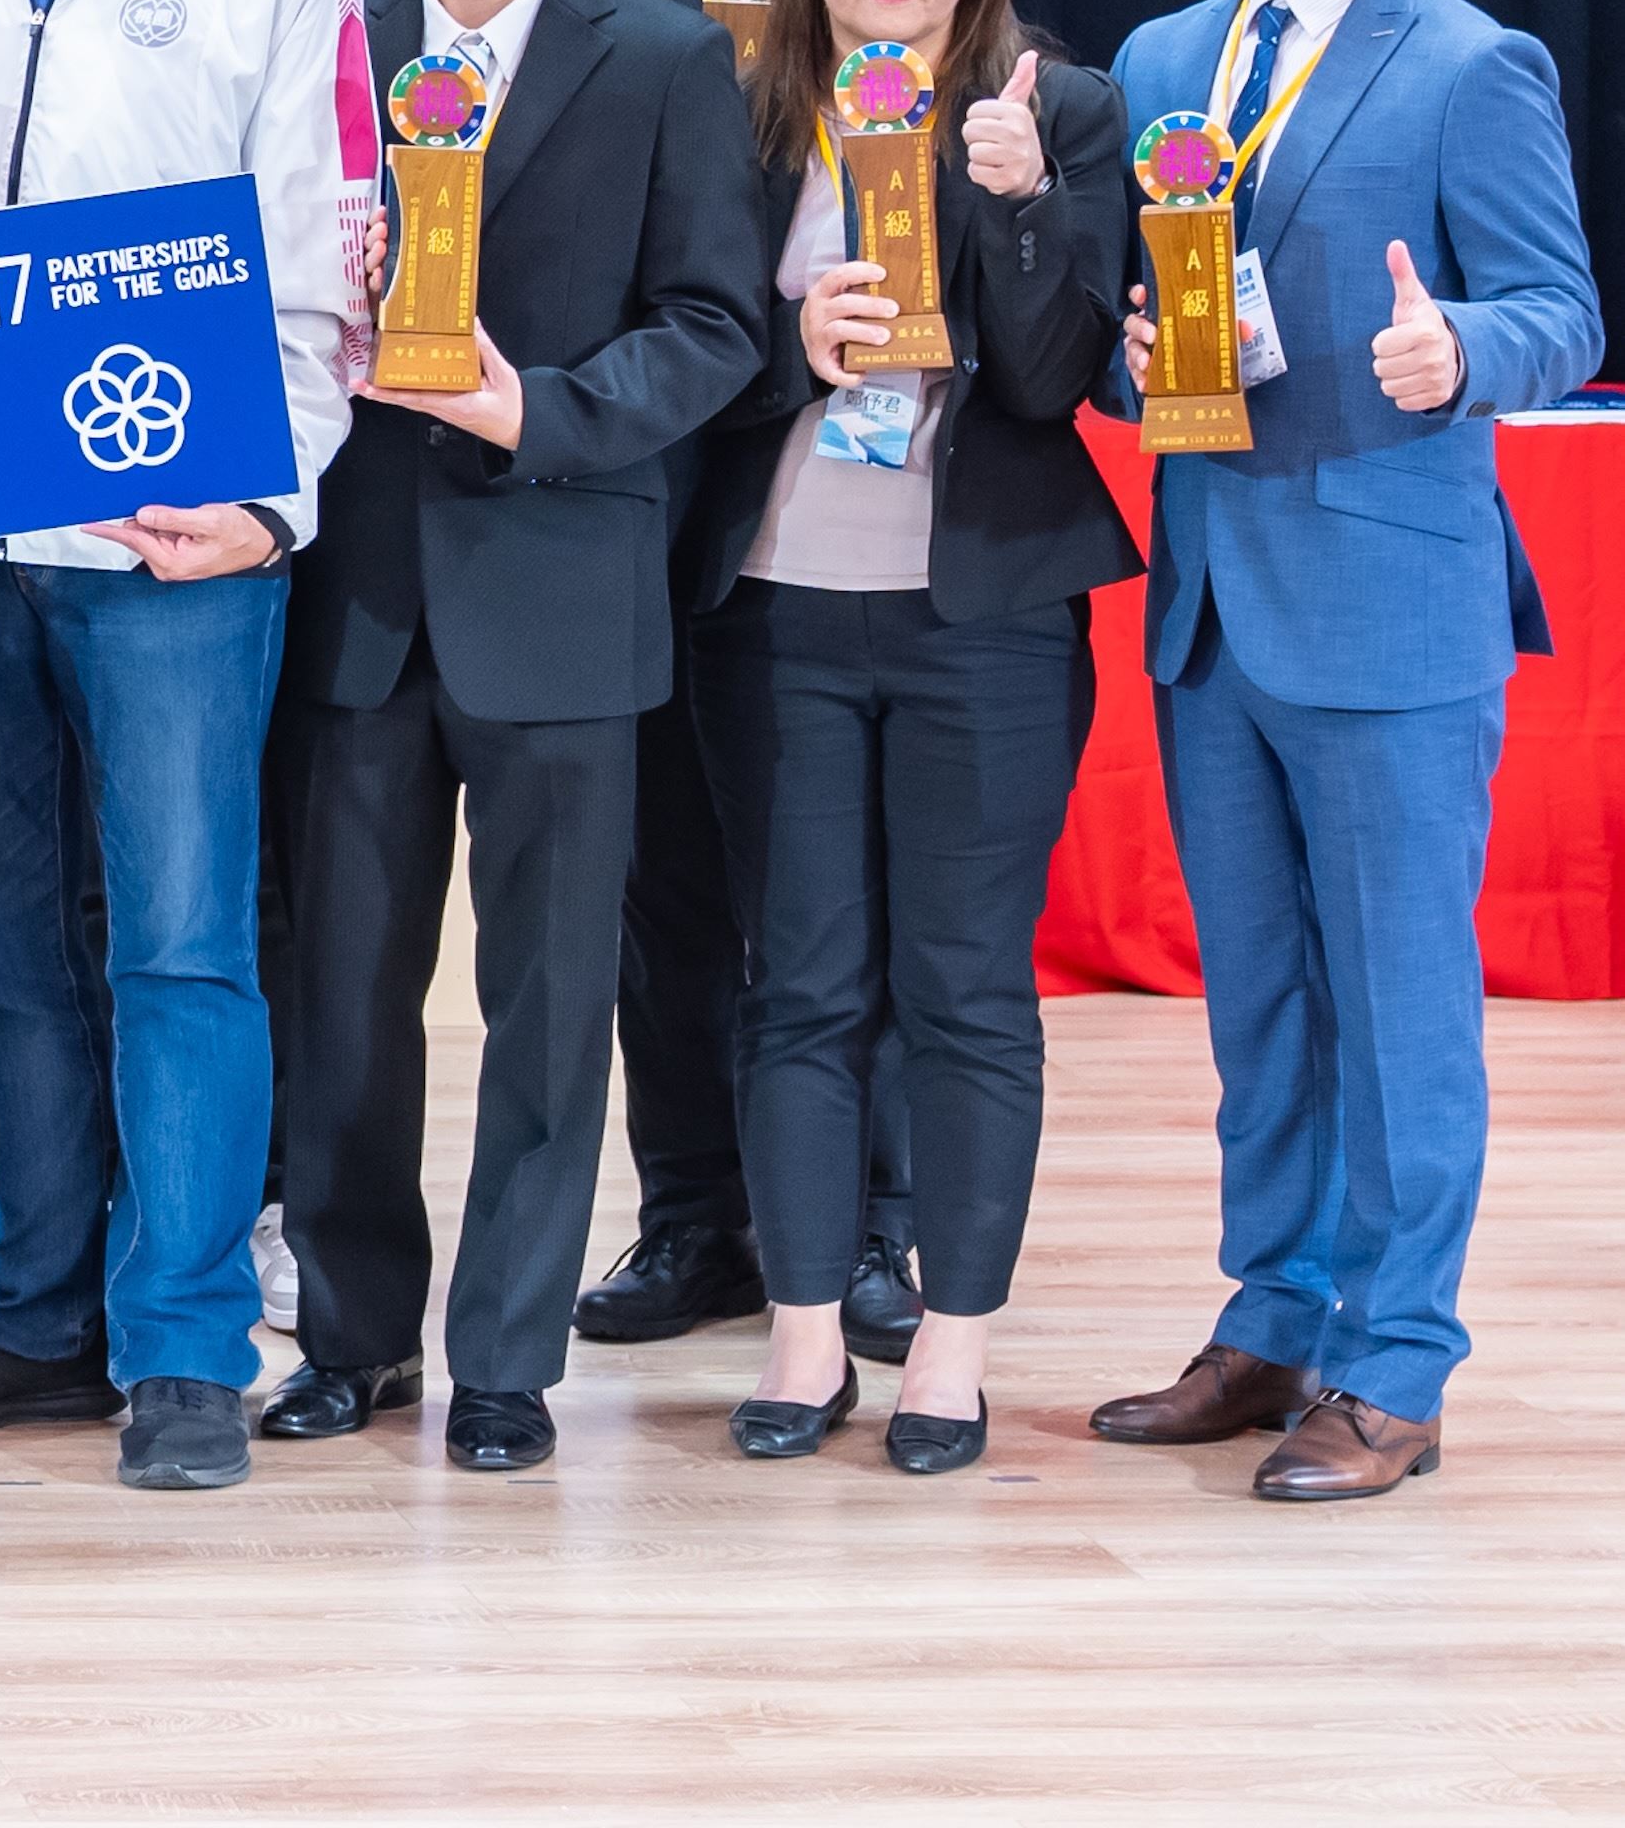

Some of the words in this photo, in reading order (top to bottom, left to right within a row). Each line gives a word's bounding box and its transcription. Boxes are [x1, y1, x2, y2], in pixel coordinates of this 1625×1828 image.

[884, 209, 913, 239] 級
[427, 227, 455, 256] 級
[46, 233, 230, 283] PARTNERSHIPS
[50, 281, 101, 310] FOR
[113, 271, 163, 300] THE
[174, 258, 250, 291] GOALS
[1181, 288, 1210, 318] 級
